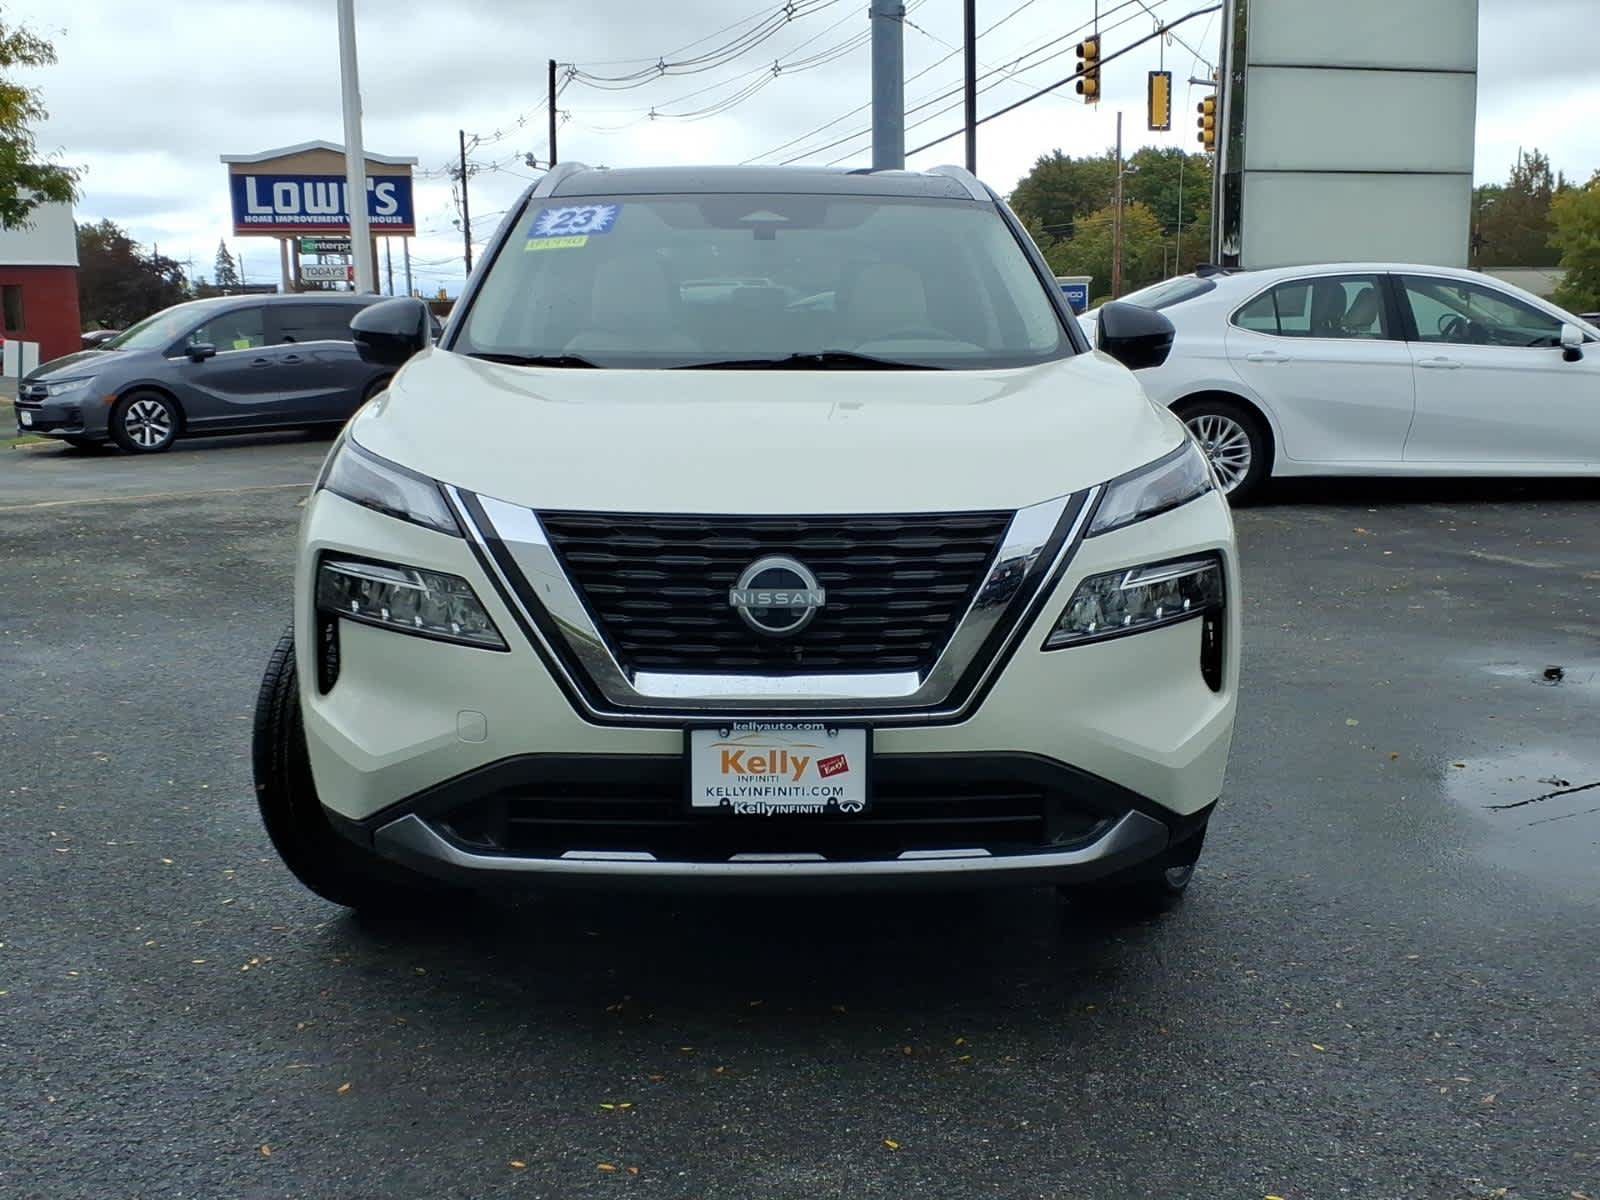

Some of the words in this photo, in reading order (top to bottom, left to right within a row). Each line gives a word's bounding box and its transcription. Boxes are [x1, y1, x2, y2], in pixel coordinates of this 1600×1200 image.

[244, 215, 273, 223] HOME
[275, 215, 343, 223] IMPROVEMENT
[345, 215, 402, 223] WHOUSE
[550, 209, 597, 230] 23
[305, 267, 345, 276] TODAY'S
[732, 593, 822, 604] NISSAN
[733, 722, 825, 731] kellyauto.com
[721, 750, 810, 782] Kelly
[706, 786, 844, 797] KELLYINFINITI.COM
